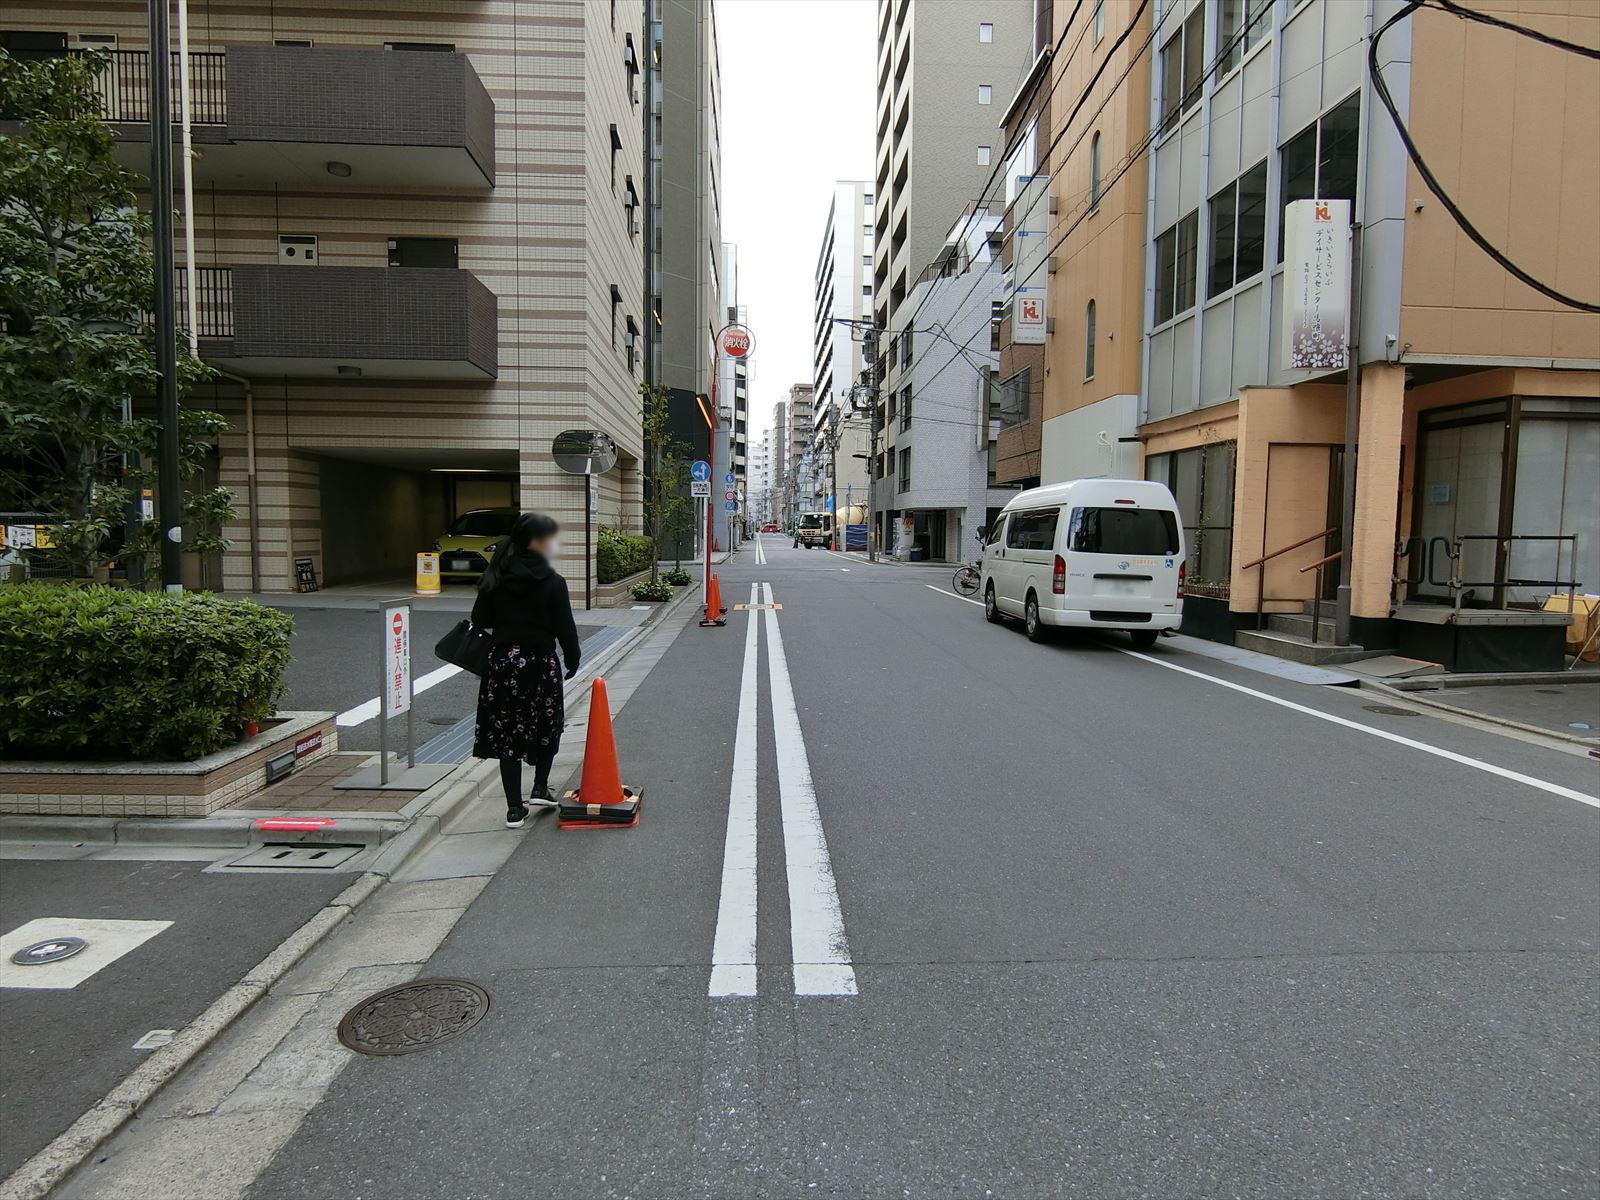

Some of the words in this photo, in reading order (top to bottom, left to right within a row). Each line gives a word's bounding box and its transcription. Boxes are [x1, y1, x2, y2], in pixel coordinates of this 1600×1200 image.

[725, 337, 748, 350] 消火栓
[394, 638, 402, 709] 進入禁止
